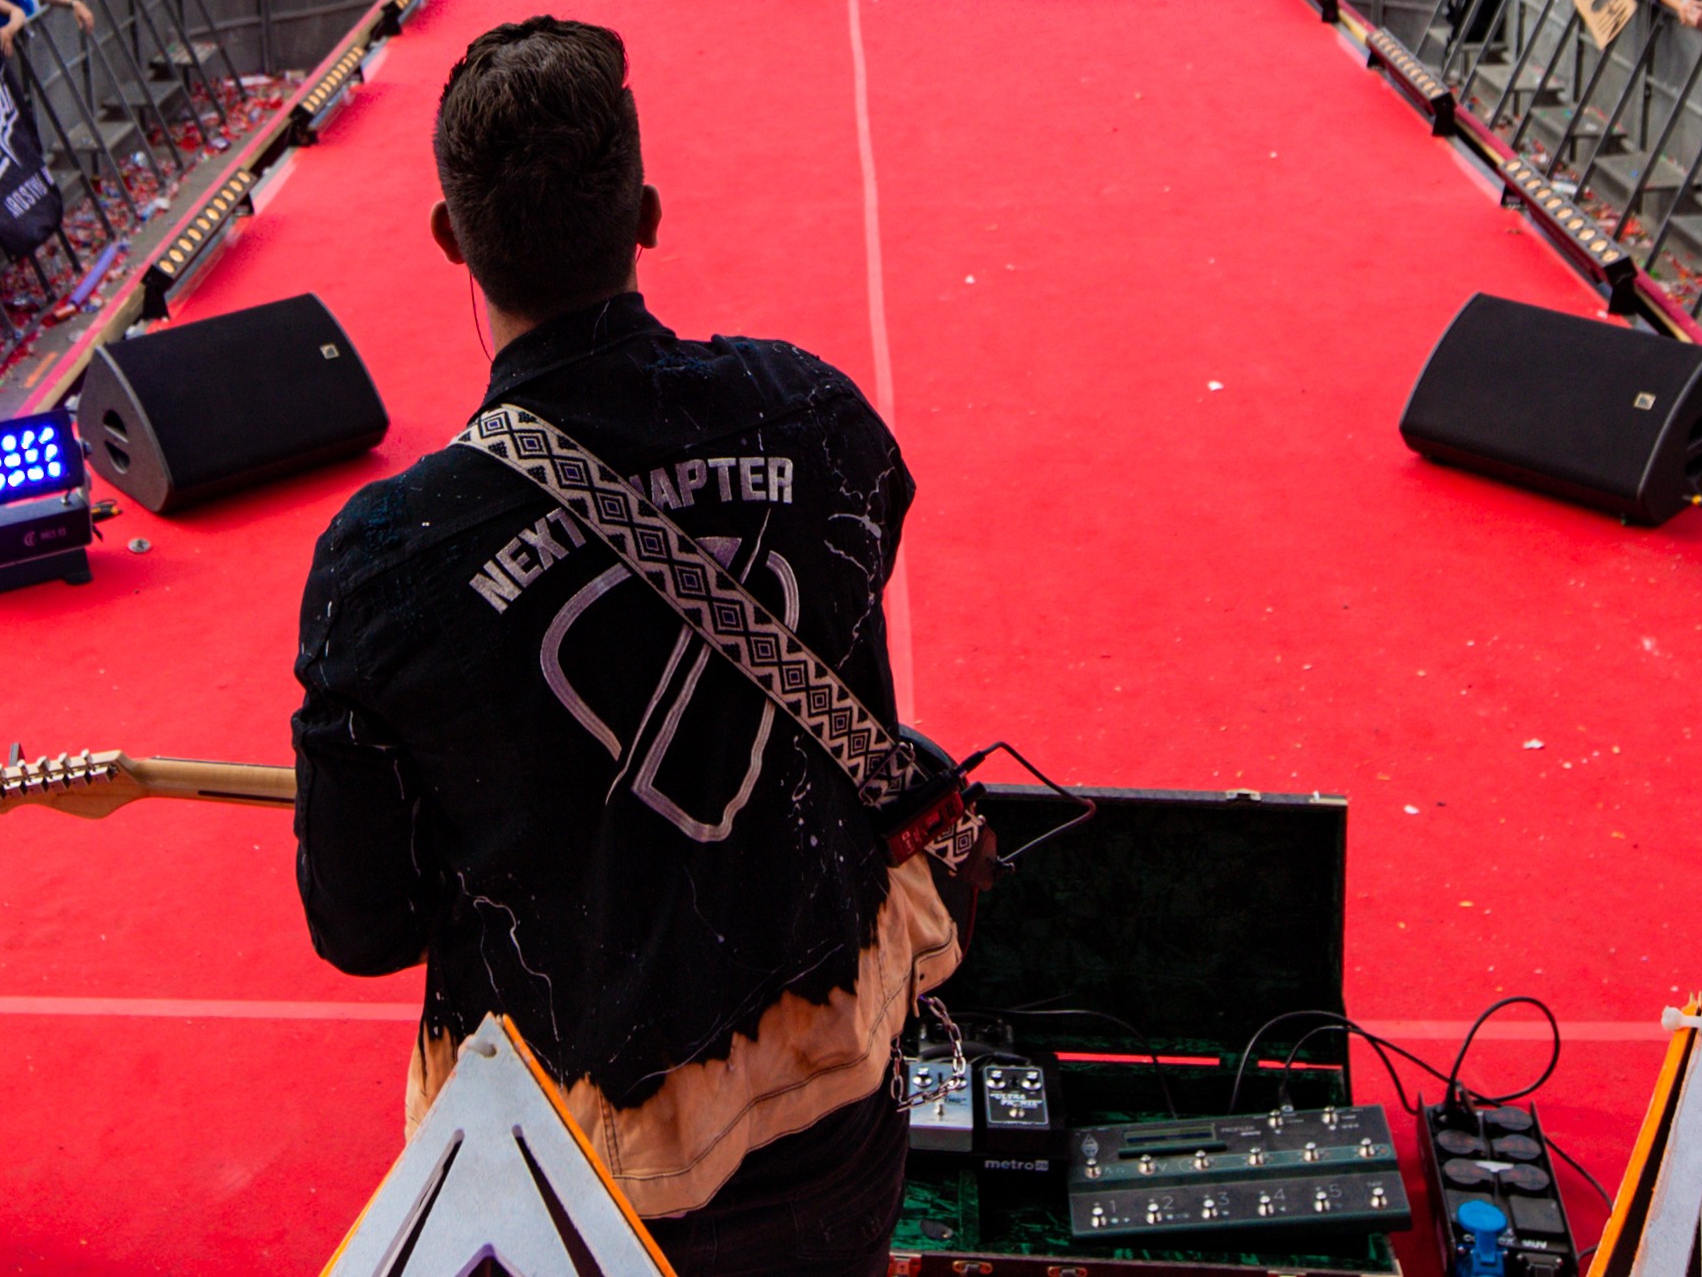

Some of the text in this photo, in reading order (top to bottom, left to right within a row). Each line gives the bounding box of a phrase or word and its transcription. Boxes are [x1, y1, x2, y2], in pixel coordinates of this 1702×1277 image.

[469, 507, 587, 614] NEXT
[1218, 1191, 1230, 1206] 3
[1273, 1188, 1286, 1201] 4
[1329, 1184, 1342, 1199] 5
[1109, 1199, 1117, 1213] 1
[1162, 1195, 1175, 1210] 2
